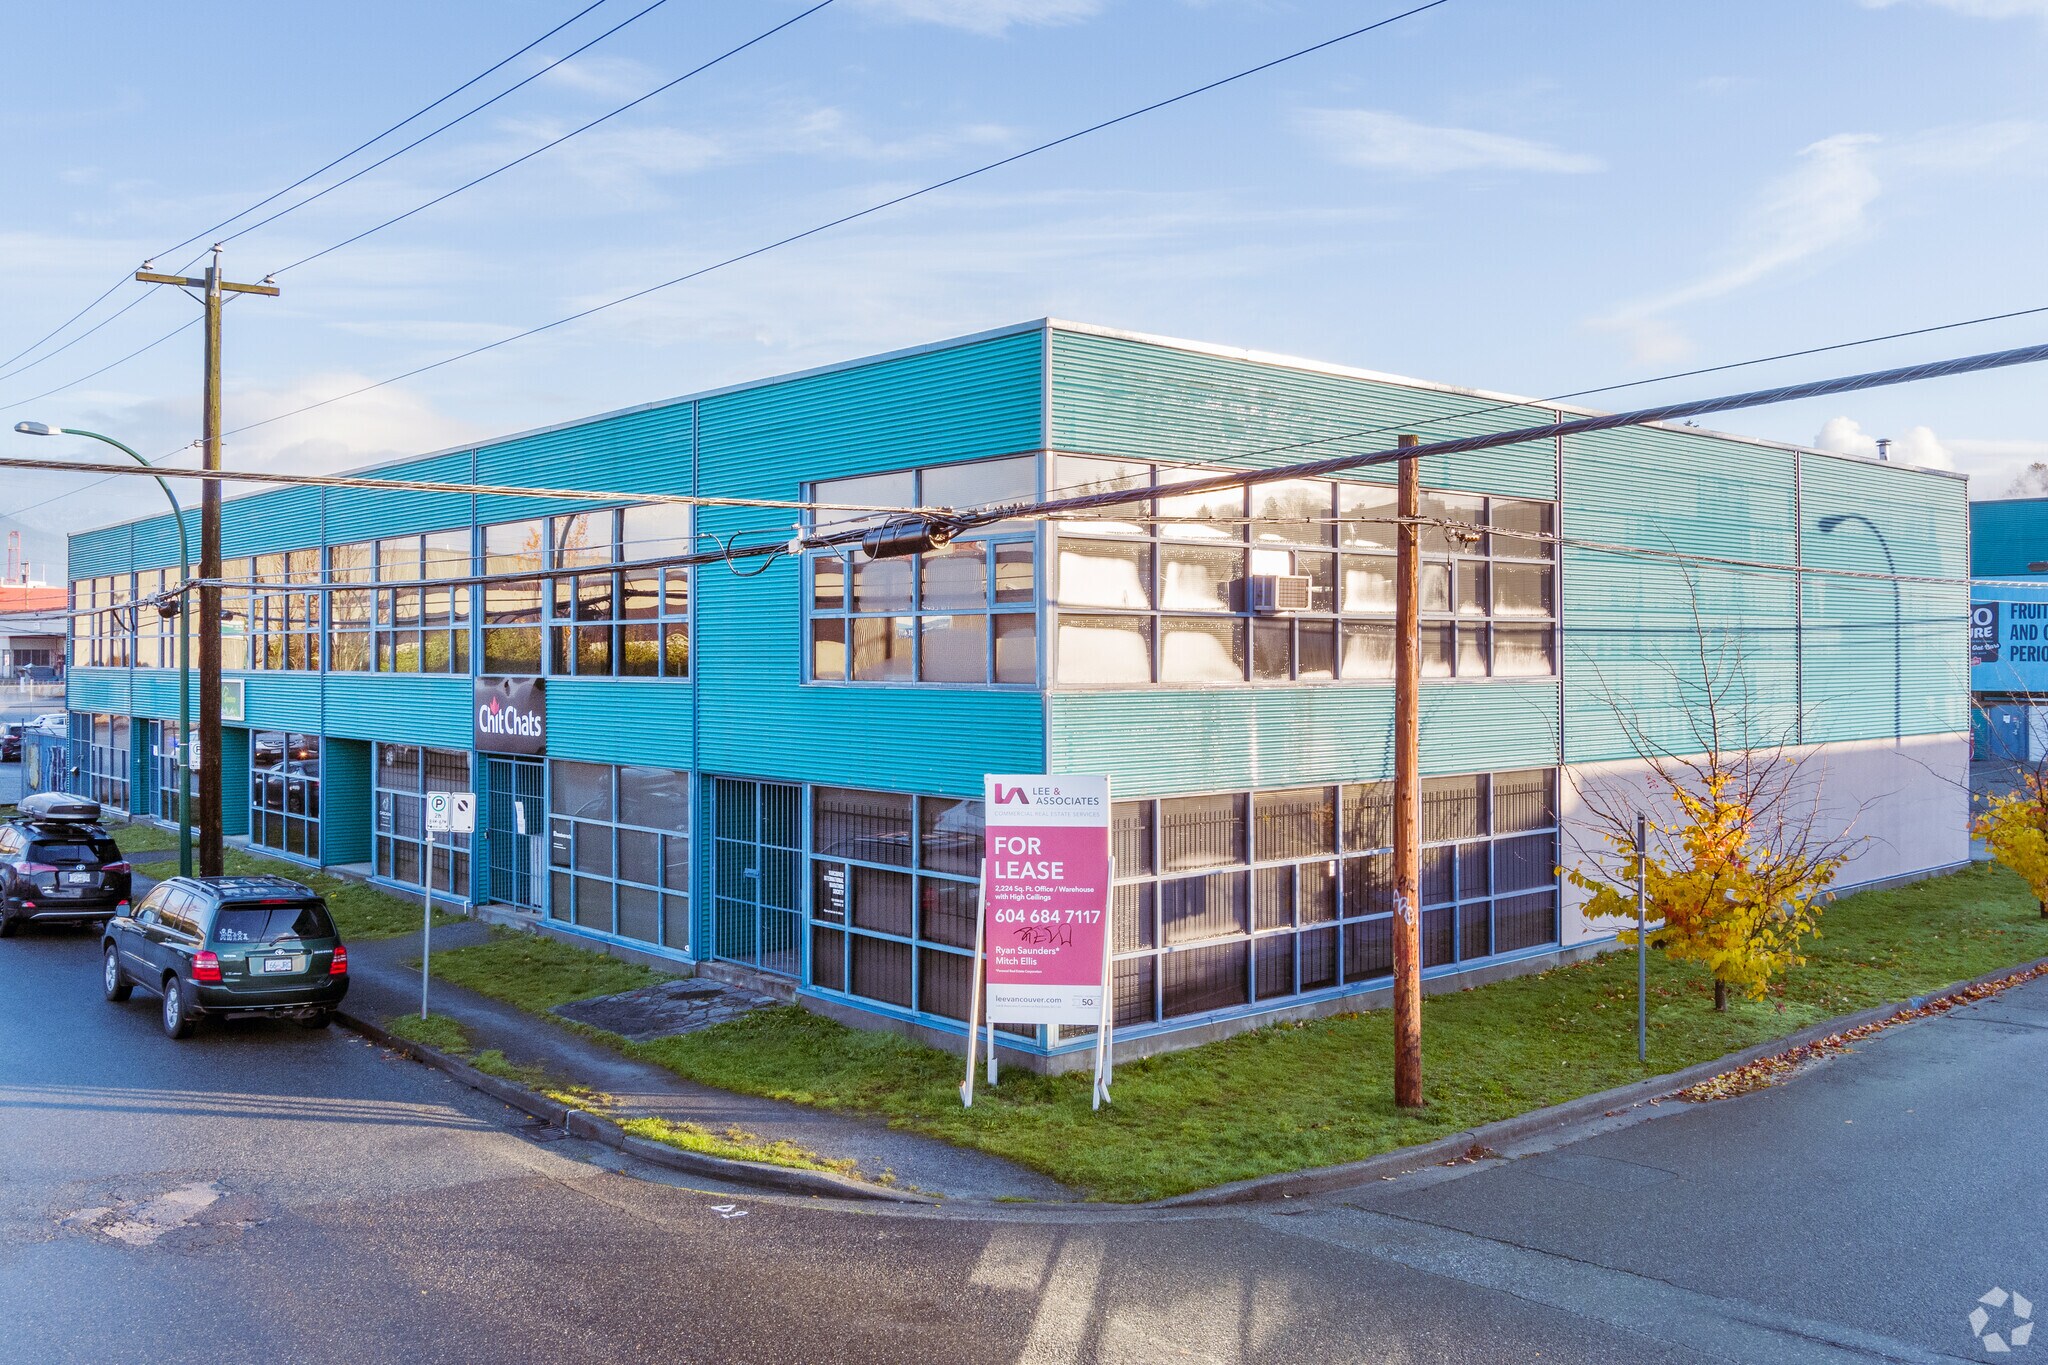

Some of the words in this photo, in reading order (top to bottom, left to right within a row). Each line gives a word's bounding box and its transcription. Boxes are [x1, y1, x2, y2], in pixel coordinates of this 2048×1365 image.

[2010, 625, 2038, 640] AND
[1032, 787, 1050, 796] LEE
[1053, 787, 1061, 796] &
[435, 798, 443, 808] P
[1035, 797, 1100, 806] ASSOCIATES
[995, 836, 1041, 856] FOR
[995, 861, 1064, 880] LEASE
[995, 885, 1013, 893] 2,224
[1014, 885, 1024, 894] Sq.
[1034, 885, 1054, 893] Office
[1009, 894, 1025, 902] High
[1026, 894, 1051, 902] Ceilings
[995, 908, 1026, 923] 604
[1030, 909, 1061, 924] 684
[1065, 910, 1101, 924] 7117
[995, 946, 1016, 956] Ryan
[995, 957, 1018, 965] Mitch
[1020, 957, 1038, 966] Ellis
[995, 995, 1062, 1003] leevancouver.com
[1082, 998, 1093, 1006] 50
